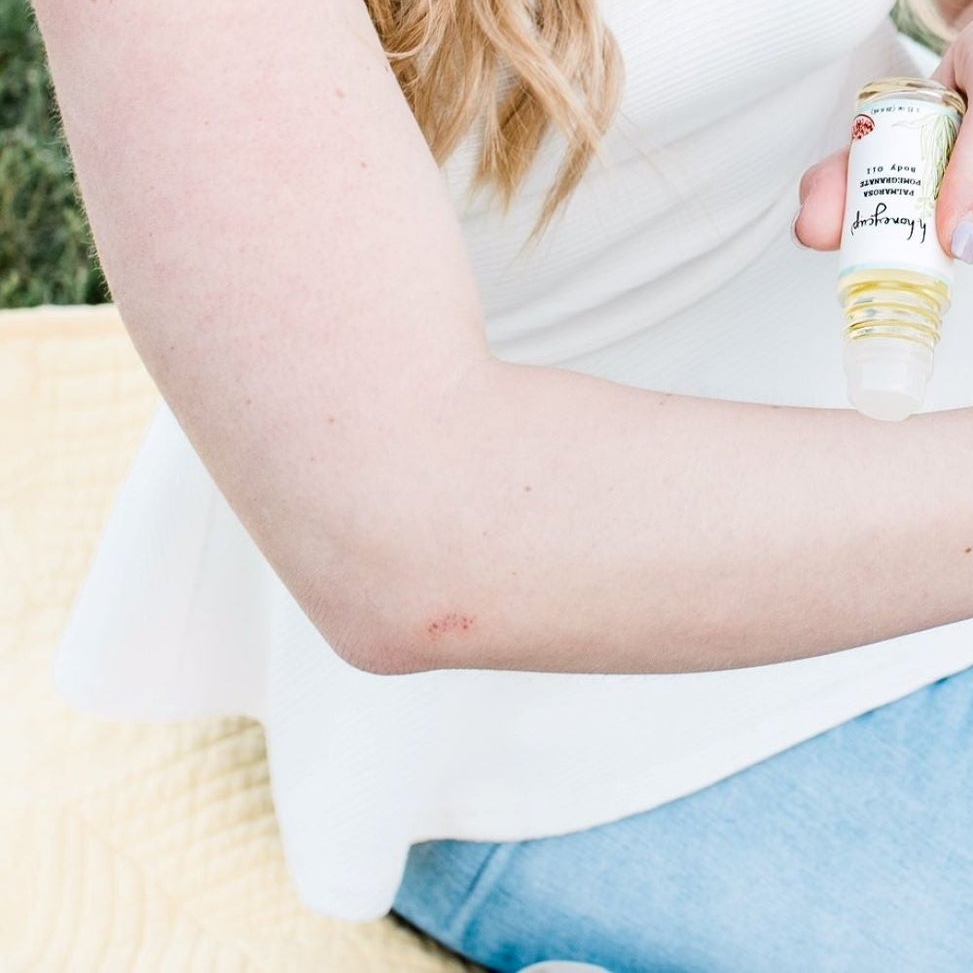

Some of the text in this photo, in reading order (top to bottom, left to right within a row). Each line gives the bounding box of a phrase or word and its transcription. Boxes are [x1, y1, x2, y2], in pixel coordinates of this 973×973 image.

[866, 164, 916, 175] Body Oil
[859, 177, 921, 188] POMEGRANATE
[863, 188, 914, 198] PALMAROSA
